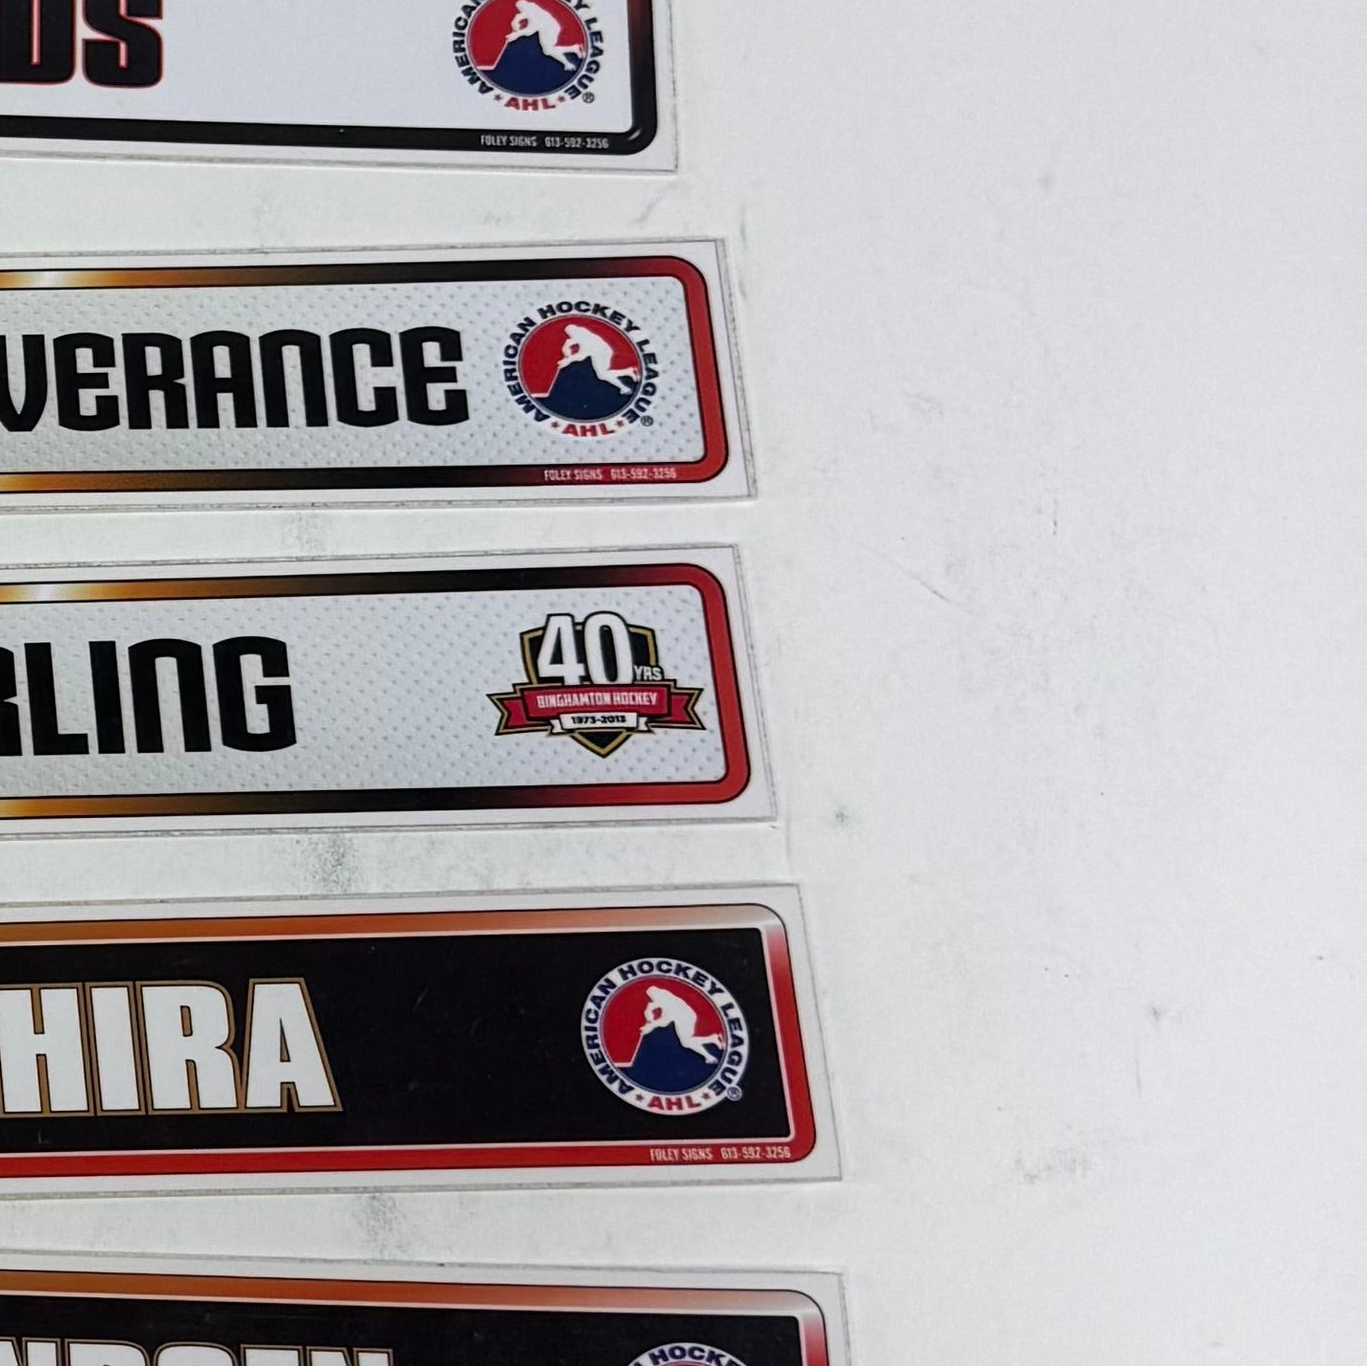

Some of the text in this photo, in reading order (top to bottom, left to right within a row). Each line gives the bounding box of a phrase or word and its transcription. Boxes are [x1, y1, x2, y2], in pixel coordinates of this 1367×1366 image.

[564, 17, 604, 101] LEAGUE
[504, 97, 557, 111] AHL
[481, 136, 507, 146] FOLEY
[509, 137, 537, 147] SIGNS
[504, 301, 659, 425] AMERICAN HOCKEY LEAGUE
[562, 423, 615, 437] AHL
[538, 612, 662, 686] 40 YRS
[536, 692, 658, 708] BINGHAMTON HOCKEY
[584, 959, 745, 1096] AMERICAN HOCKEY LEAGUE
[647, 1097, 701, 1111] AHL
[650, 1148, 679, 1161] FOLEY
[682, 1148, 713, 1160] SIGNS
